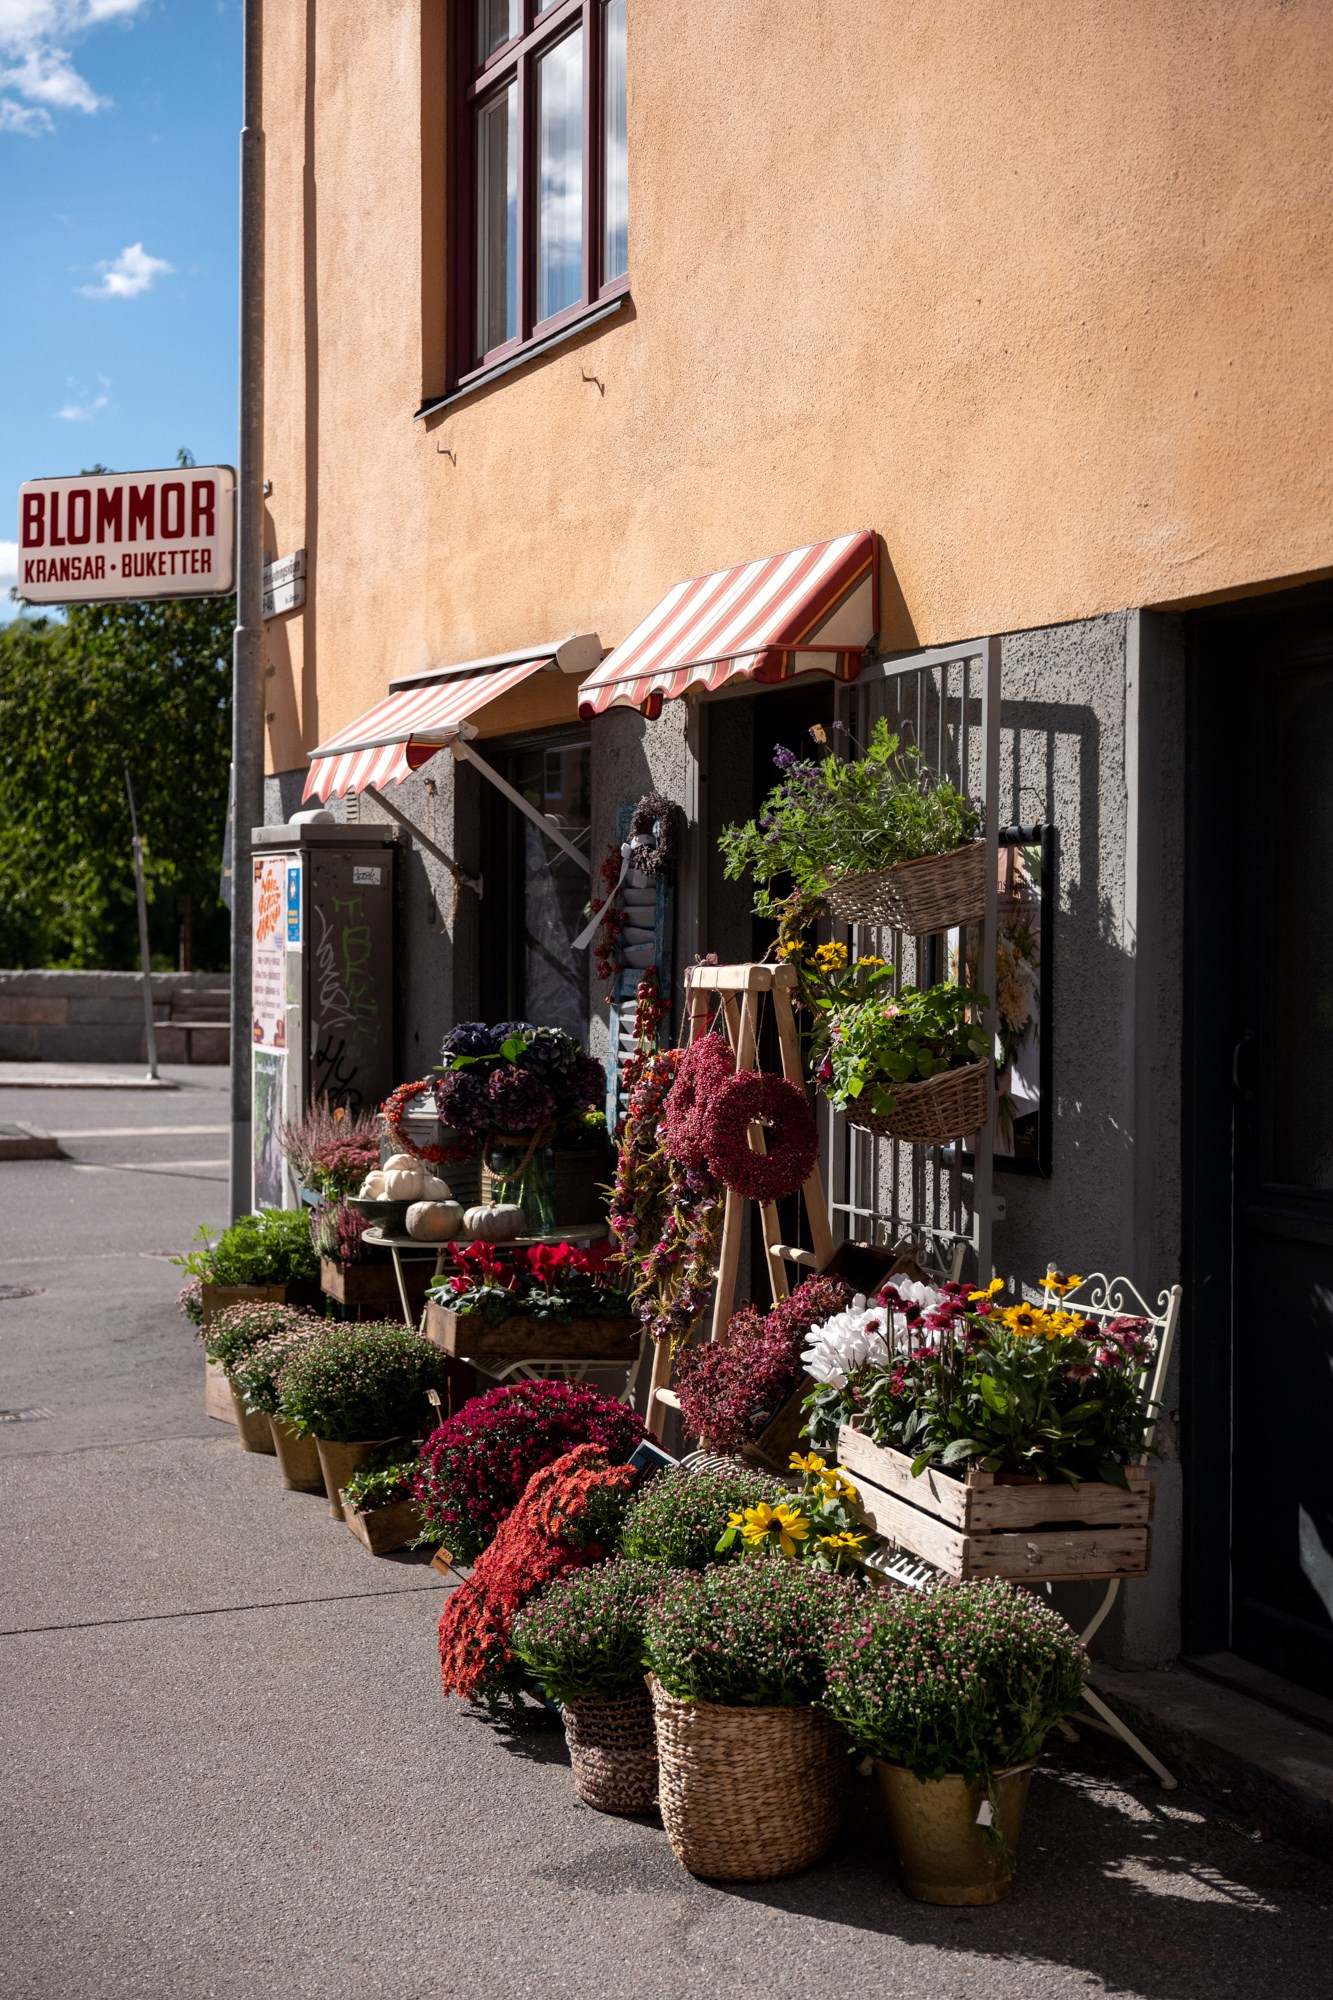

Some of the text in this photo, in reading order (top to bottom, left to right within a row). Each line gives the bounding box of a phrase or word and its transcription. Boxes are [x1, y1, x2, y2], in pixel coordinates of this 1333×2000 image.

[22, 480, 215, 548] BLOMMOR
[24, 549, 212, 584] KRANSAR BUKETTER
